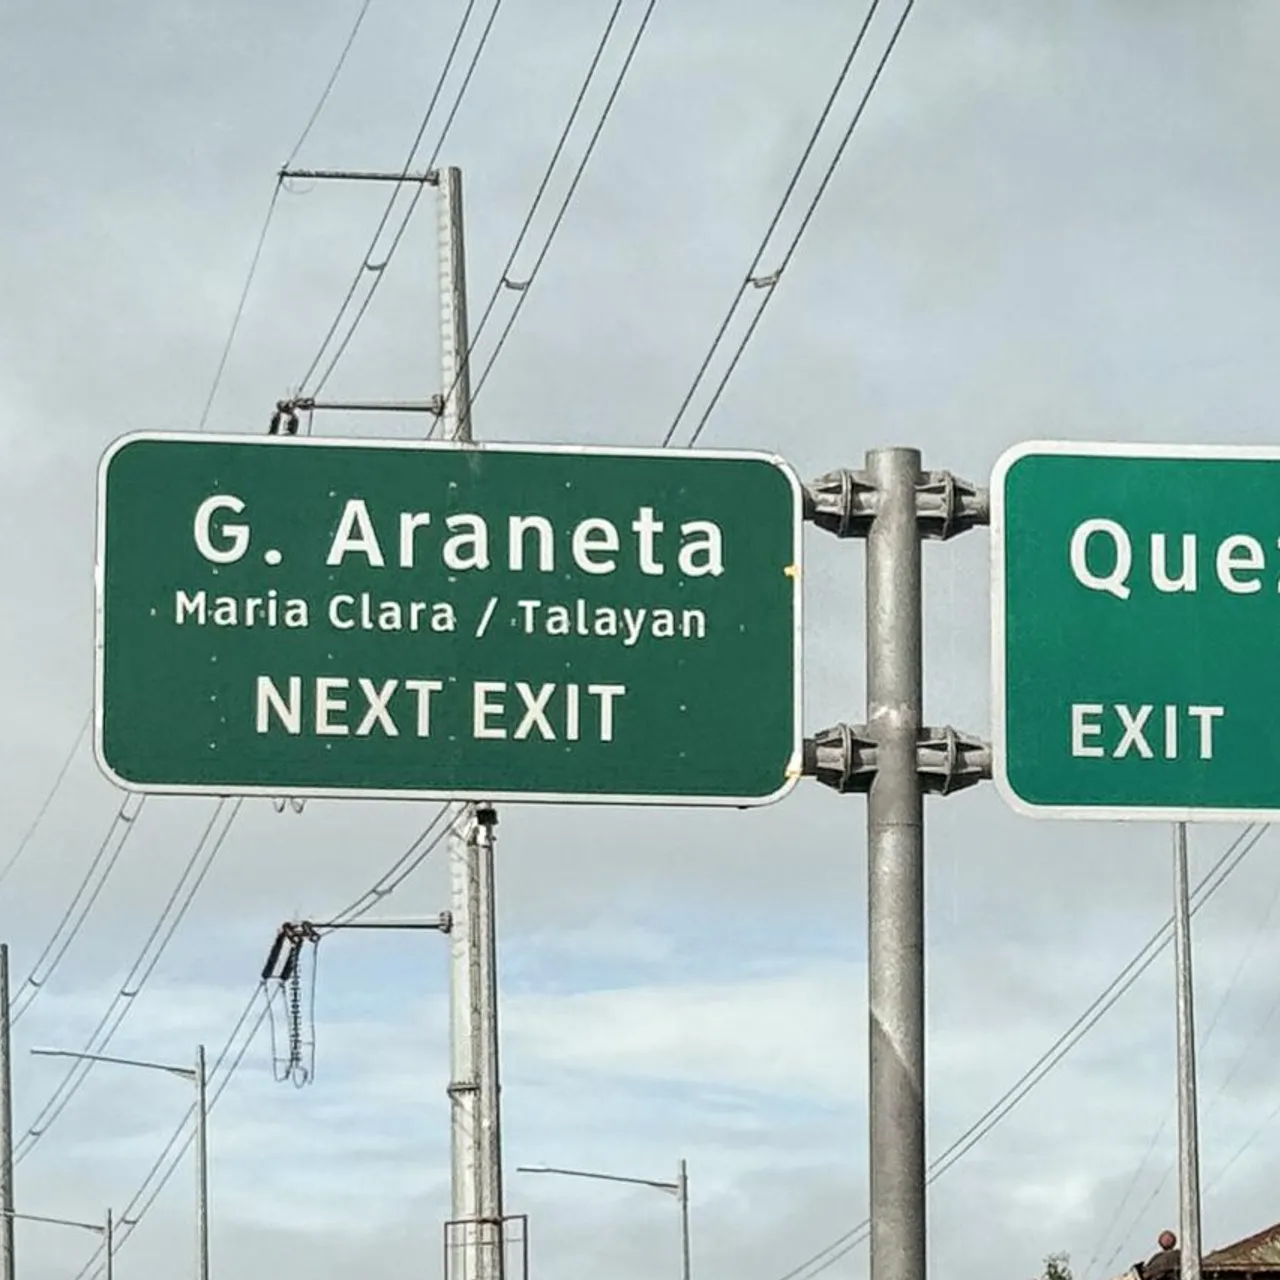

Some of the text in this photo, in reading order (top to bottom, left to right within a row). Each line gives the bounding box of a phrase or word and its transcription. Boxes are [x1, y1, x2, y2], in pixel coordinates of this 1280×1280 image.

[194, 494, 725, 578] G. Araneta
[175, 590, 707, 646] Maria Clara / Talayan
[256, 675, 627, 742] NEXT EXIT
[1070, 703, 1226, 760] EXIT
